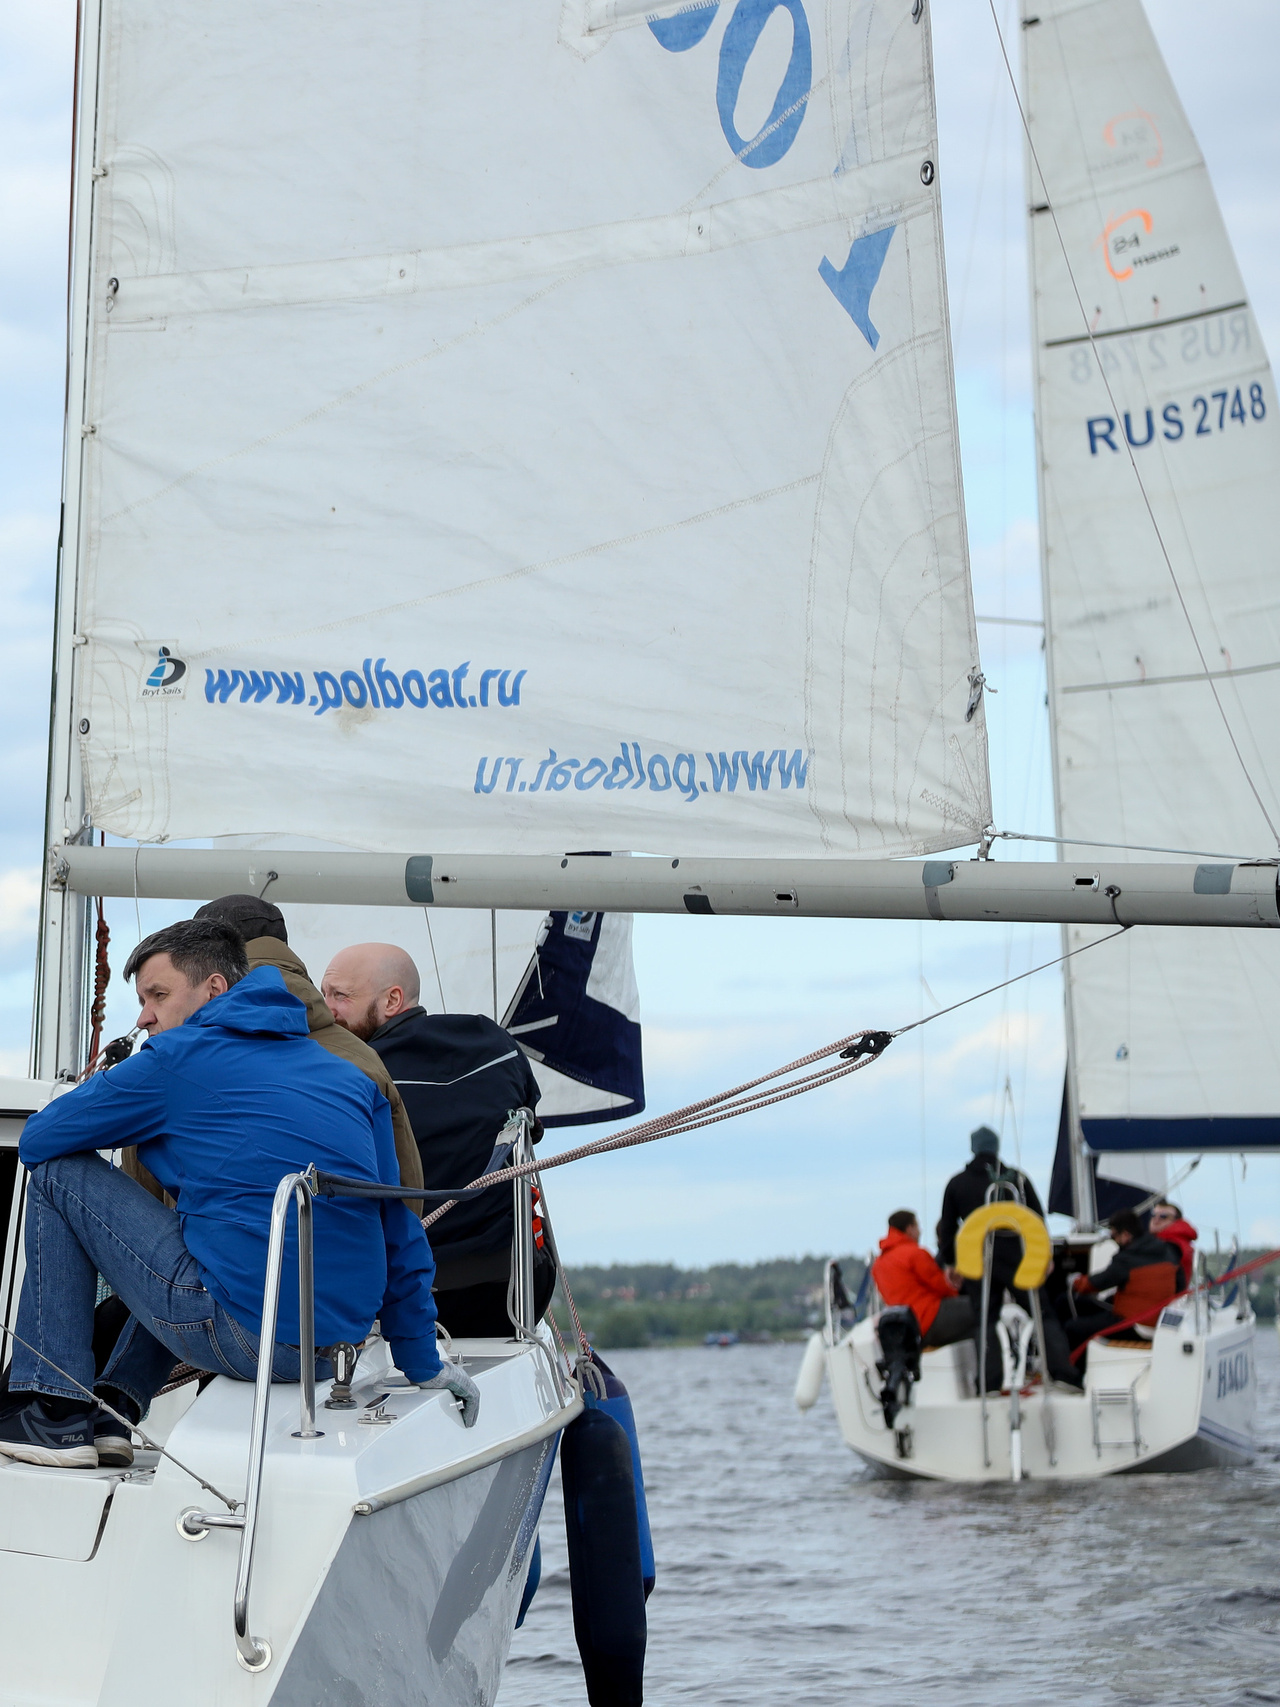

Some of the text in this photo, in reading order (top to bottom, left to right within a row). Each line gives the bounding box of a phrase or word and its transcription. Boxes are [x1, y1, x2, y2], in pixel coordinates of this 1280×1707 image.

[1087, 381, 1266, 456] RUS 2748
[142, 687, 182, 697] Bryt Sails
[205, 658, 527, 715] www.polboat.ru
[61, 1434, 84, 1443] FILA
